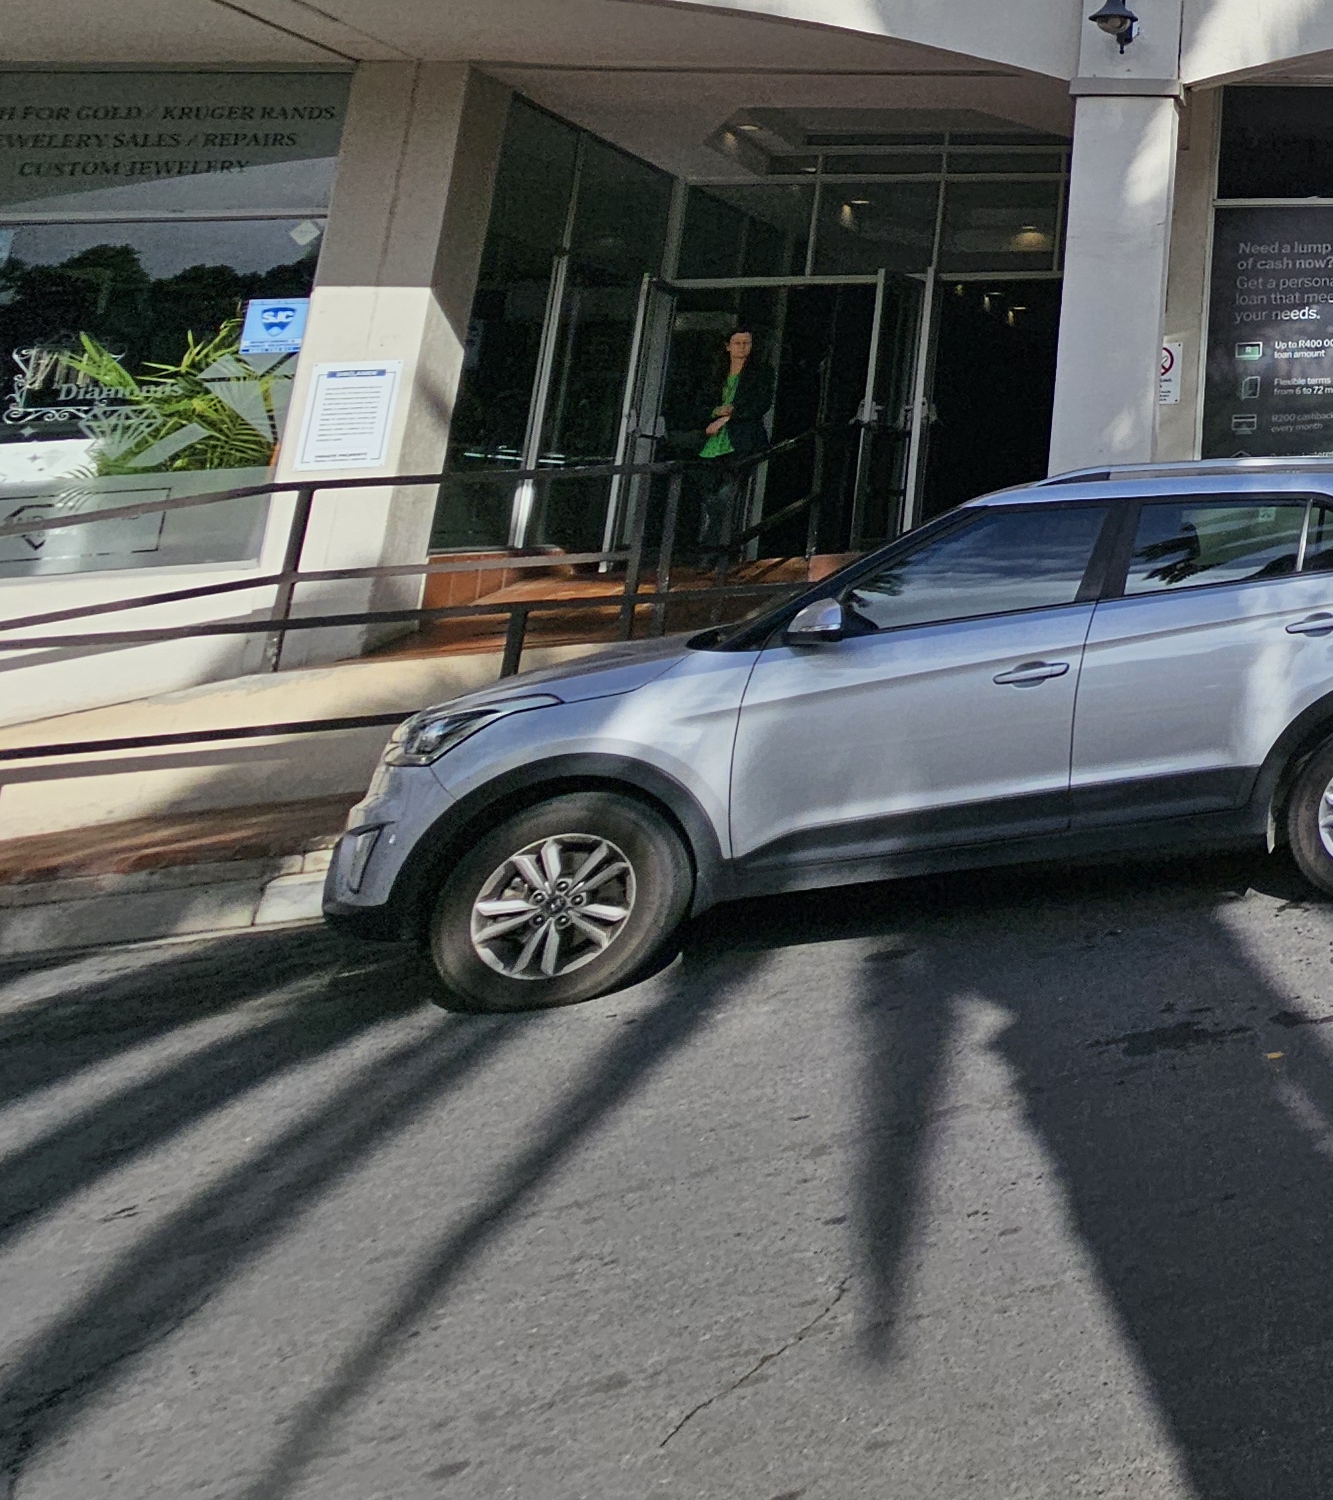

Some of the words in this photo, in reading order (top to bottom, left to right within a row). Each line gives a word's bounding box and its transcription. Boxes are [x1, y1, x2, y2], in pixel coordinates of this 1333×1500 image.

[22, 106, 70, 120] FOR
[162, 106, 254, 120] KRUGER
[259, 106, 336, 120] RANDS
[202, 132, 298, 148] REPAIRS
[17, 161, 120, 177] CUSTOM
[1238, 242, 1279, 254] Need
[1281, 244, 1291, 254] a
[1294, 241, 1332, 255] lump
[1237, 257, 1253, 270] of
[1257, 257, 1292, 269] cash
[1236, 276, 1263, 289] Get
[1267, 279, 1276, 289] a
[1236, 293, 1267, 306] loan
[1271, 292, 1300, 304] that
[1235, 311, 1268, 324] your
[1272, 307, 1320, 320] needs.
[1275, 341, 1288, 350] Up
[1288, 340, 1297, 349] to
[1298, 339, 1323, 349] R400
[1274, 351, 1292, 359] loan
[1294, 349, 1325, 358] amount
[1274, 377, 1306, 386] Flexible
[1307, 376, 1331, 385] terms
[1274, 387, 1294, 396] from
[1295, 386, 1301, 395] 6
[1302, 387, 1312, 395] to
[1313, 386, 1323, 394] 72
[1271, 424, 1294, 433] every
[1295, 422, 1323, 431] month
